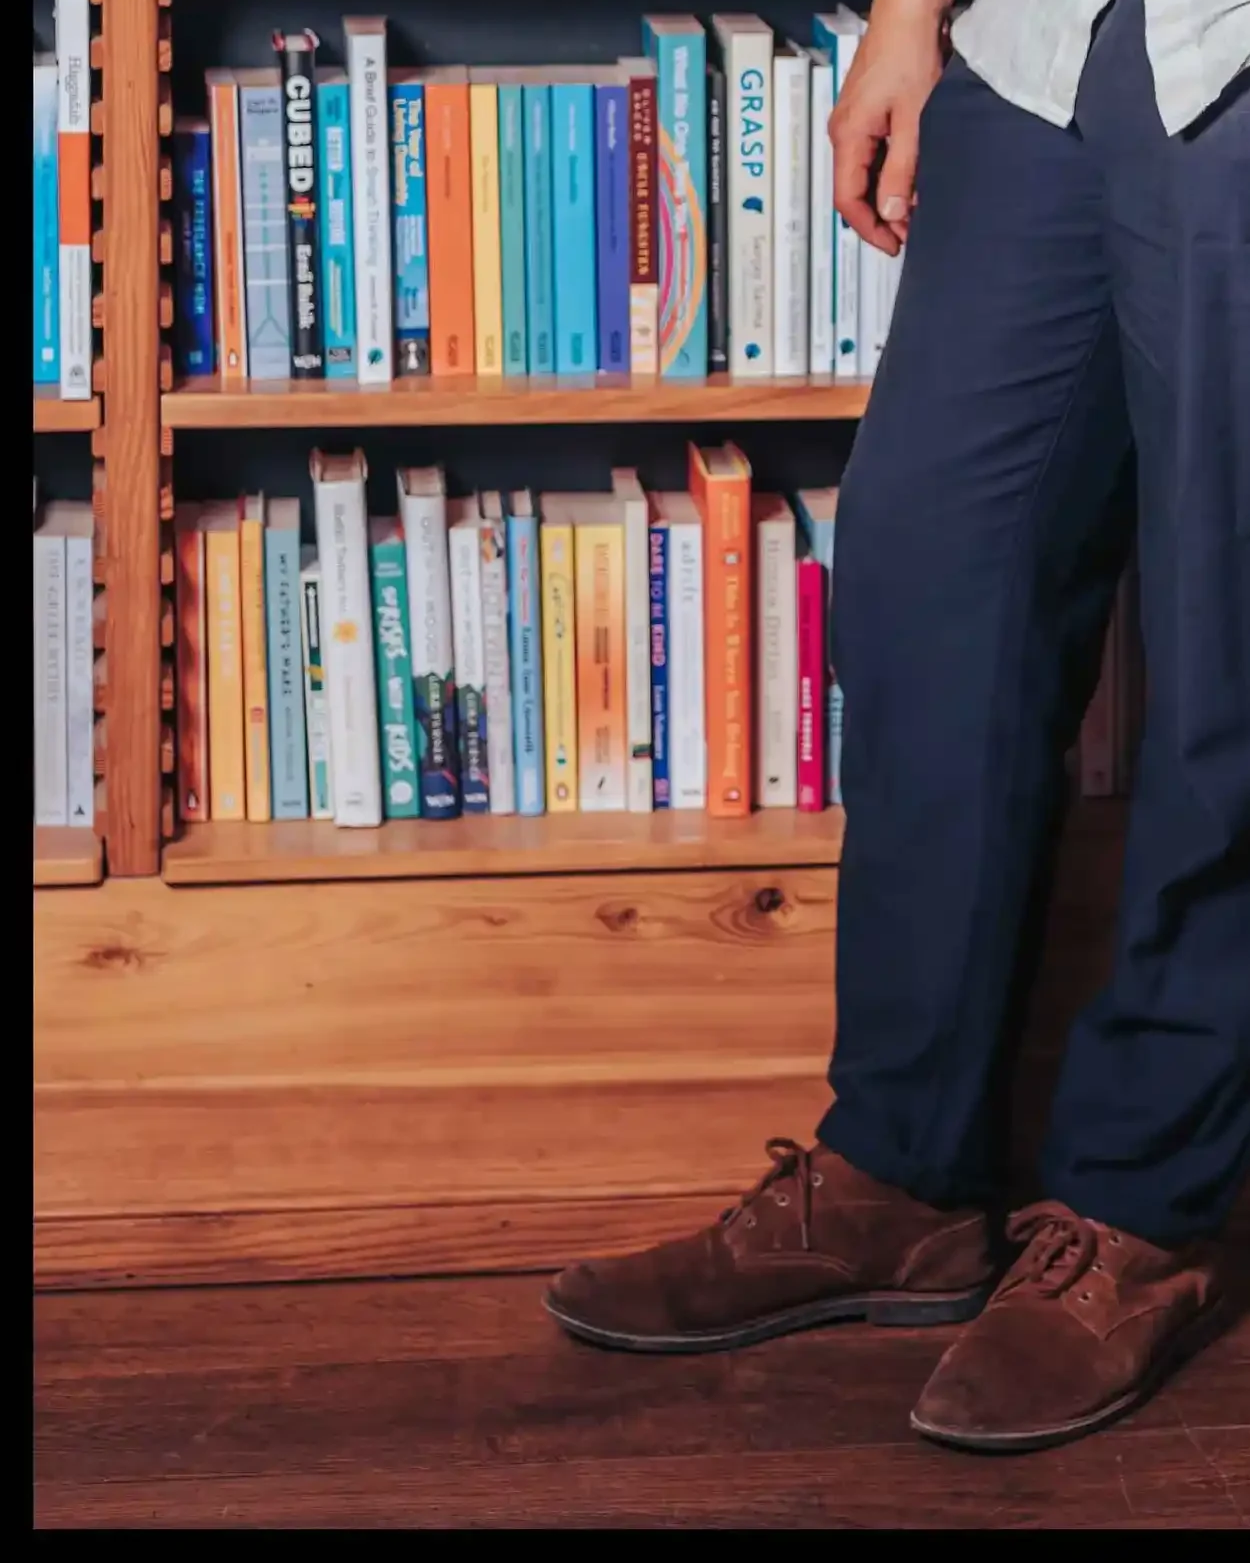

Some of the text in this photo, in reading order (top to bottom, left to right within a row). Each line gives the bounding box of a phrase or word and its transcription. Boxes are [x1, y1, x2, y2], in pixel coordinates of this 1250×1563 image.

[365, 57, 375, 67] A
[286, 75, 313, 192] CUBED
[740, 69, 764, 178] GRASP
